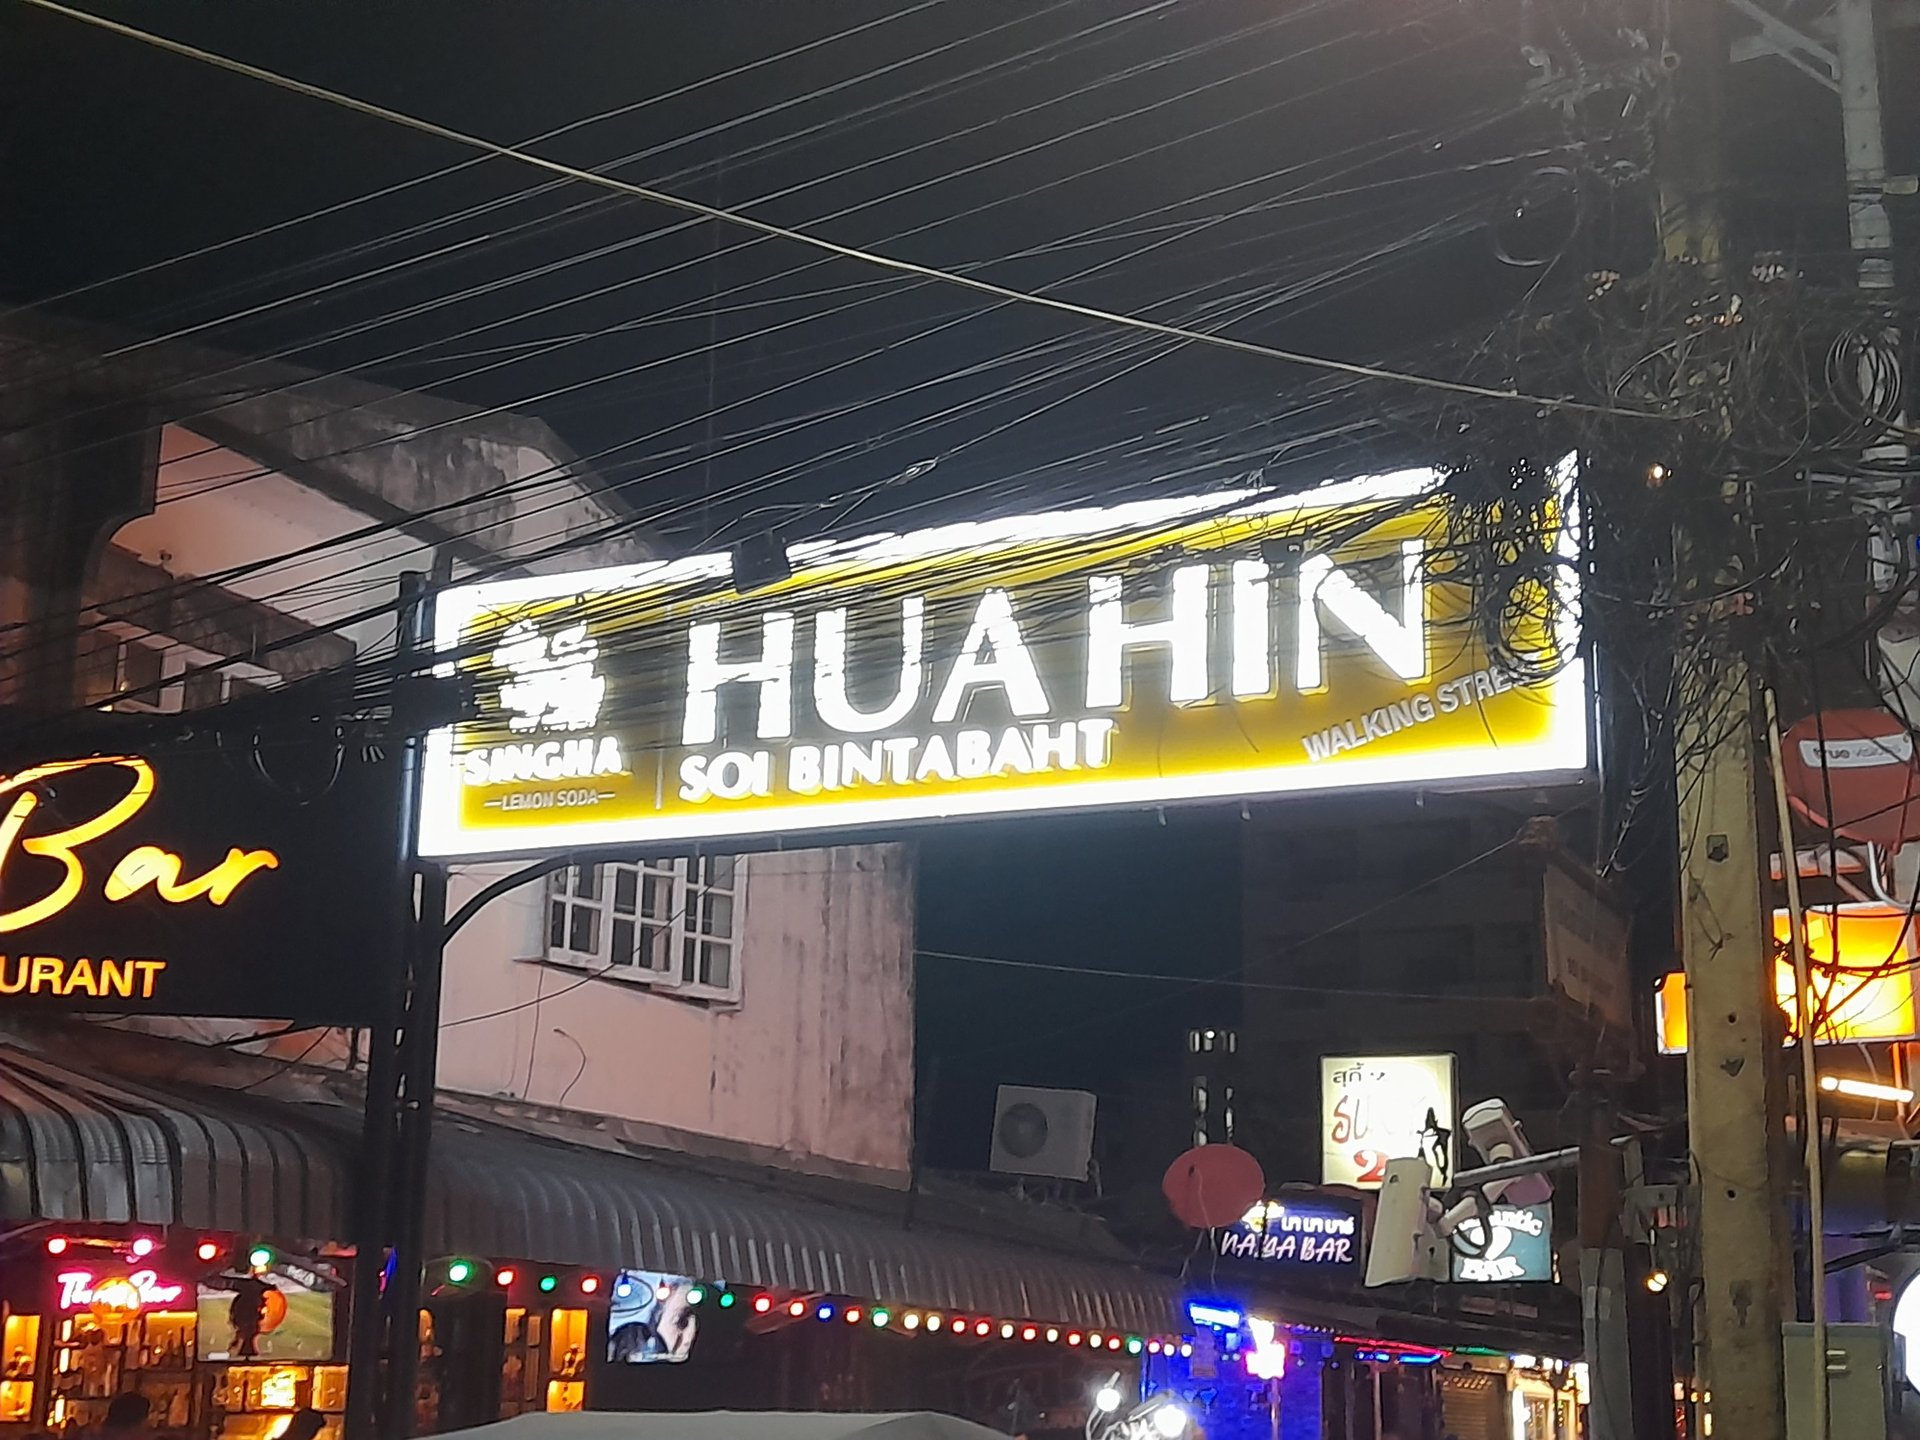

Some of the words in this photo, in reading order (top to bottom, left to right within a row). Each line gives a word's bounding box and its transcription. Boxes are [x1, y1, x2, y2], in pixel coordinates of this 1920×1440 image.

[1301, 693, 1436, 763] WALKING
[462, 736, 624, 785] SINGHA
[678, 750, 770, 803] SOI
[788, 717, 1115, 794] BINTABAHT
[502, 792, 553, 811] LEMON
[556, 789, 599, 807] SODA
[0, 753, 280, 933] Bar
[1300, 1236, 1354, 1264] BAR
